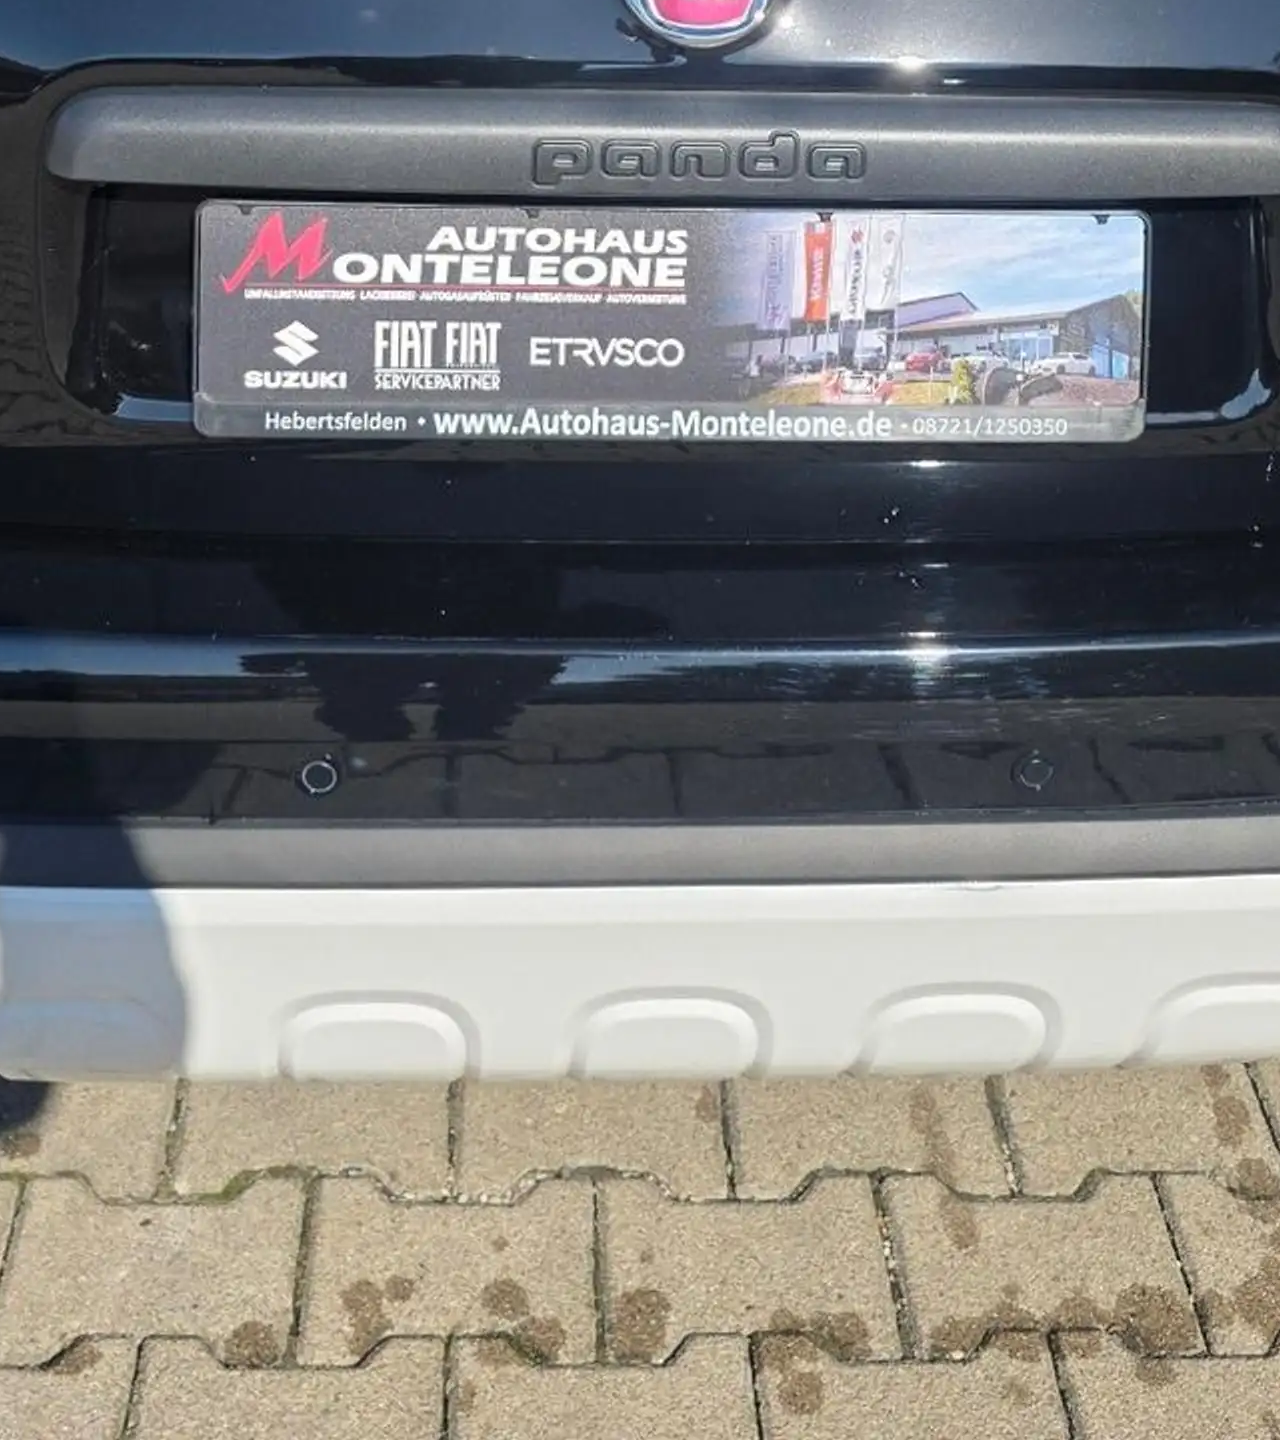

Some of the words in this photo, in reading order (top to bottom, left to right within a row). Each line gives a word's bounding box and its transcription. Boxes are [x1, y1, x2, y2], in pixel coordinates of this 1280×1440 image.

[532, 130, 867, 189] panda
[221, 210, 688, 294] MONTELEONE
[426, 226, 688, 255] AUTOHAUS
[374, 320, 437, 368] FIAT
[445, 321, 502, 365] FIAT
[244, 370, 348, 389] SUZUKI
[374, 373, 501, 391] SERVICEPARTNER
[265, 411, 407, 431] Hebertsfelden
[433, 407, 892, 441] www.Autohaus-Monteleone.de
[912, 417, 1068, 437] 08721/1250350
